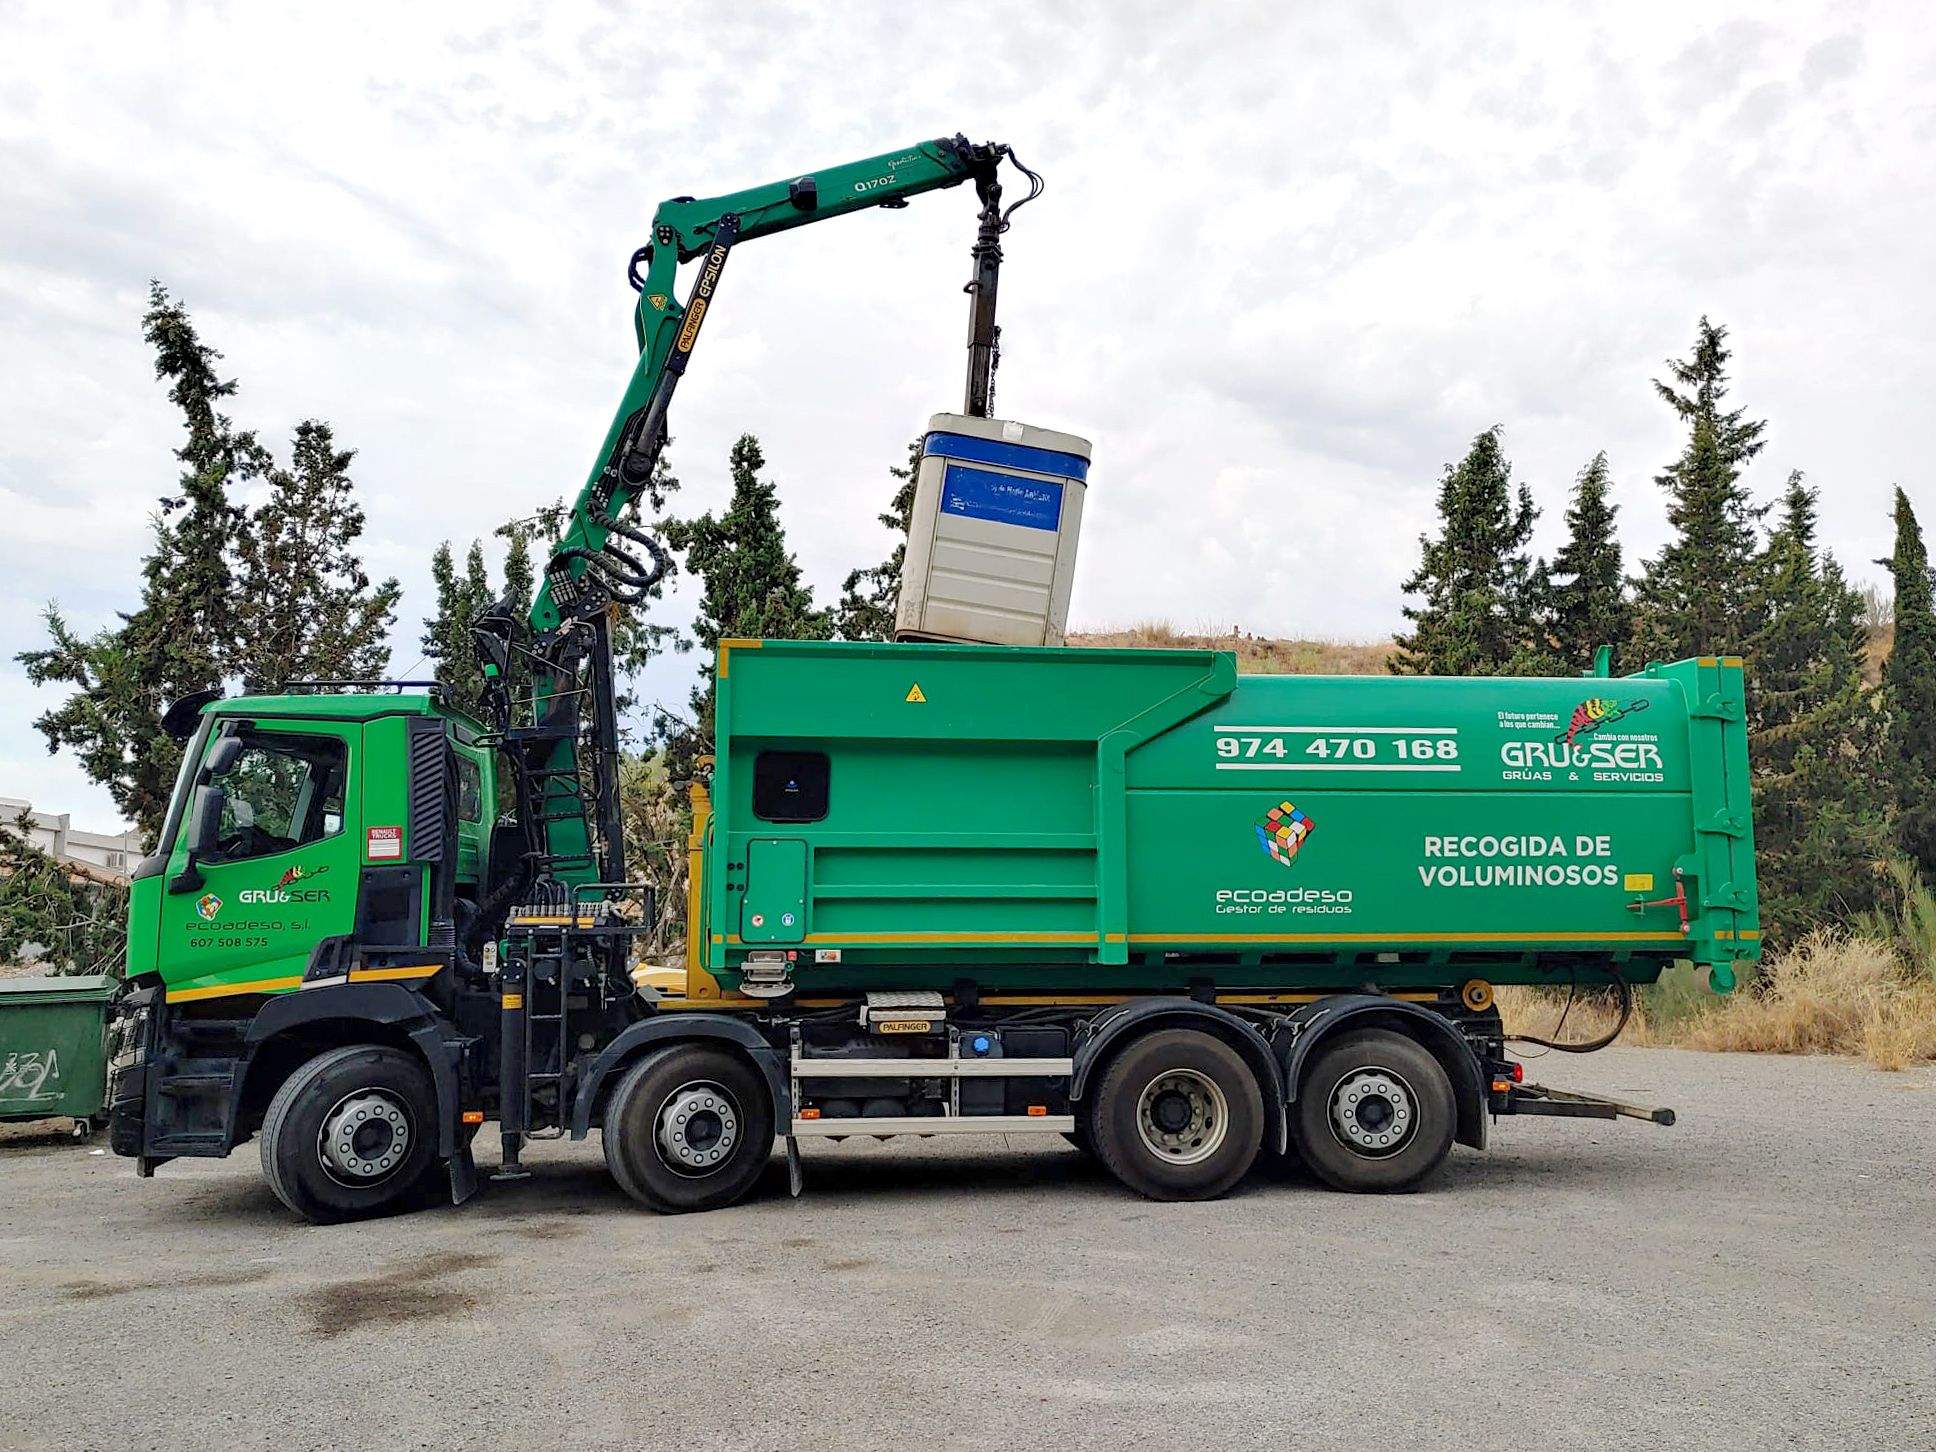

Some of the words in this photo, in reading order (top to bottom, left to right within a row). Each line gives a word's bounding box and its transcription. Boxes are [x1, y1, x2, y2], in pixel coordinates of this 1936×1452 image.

[680, 301, 704, 349] PALFINGER
[699, 245, 727, 298] EPSILON
[1526, 712, 1558, 721] pertenece
[1504, 720, 1513, 728] los
[1515, 722, 1526, 730] que
[1216, 738, 1287, 758] 974
[1305, 739, 1376, 759] 470
[1392, 740, 1458, 759] 168
[1503, 768, 1551, 780] GRÚAS
[1568, 772, 1579, 781] &
[1594, 773, 1664, 782] SERVICIOS
[1425, 836, 1567, 857] RECOGIDA
[1576, 836, 1611, 856] DE
[1418, 865, 1619, 886] VOLUMINOSOS
[1216, 887, 1352, 902] ecoadeso
[1216, 905, 1262, 914] Gestor
[1268, 905, 1286, 914] de
[185, 919, 286, 931] ecoadeso,
[190, 937, 213, 947] 607
[217, 938, 241, 947] 508
[245, 937, 268, 947] 575
[883, 1023, 928, 1032] PALFINGER
